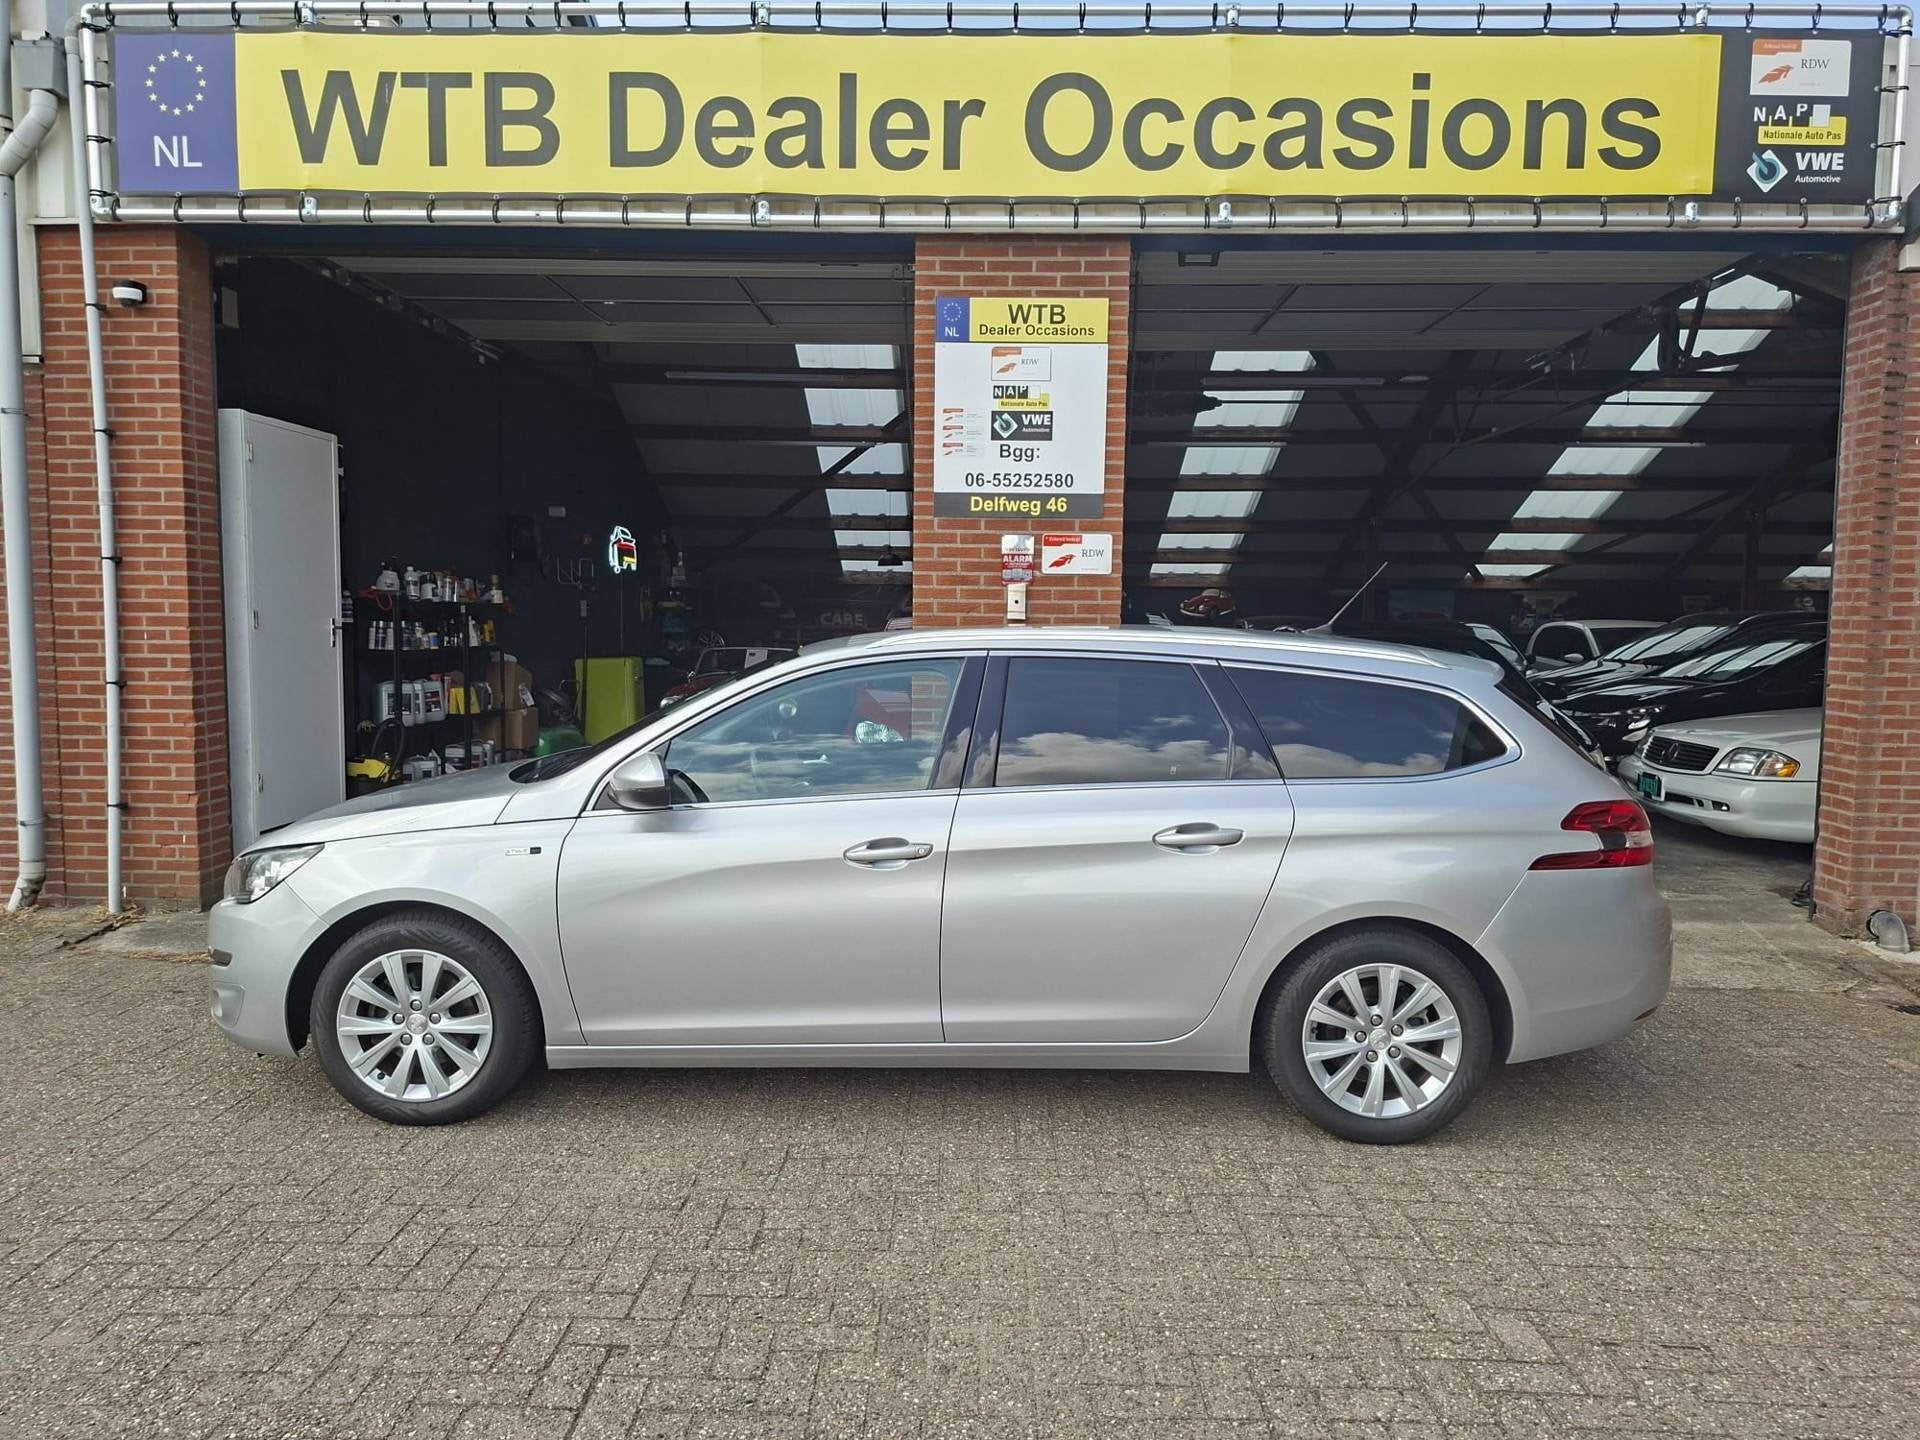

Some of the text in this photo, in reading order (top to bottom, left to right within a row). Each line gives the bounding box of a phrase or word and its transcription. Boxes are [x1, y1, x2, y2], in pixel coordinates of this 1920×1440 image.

[1800, 58, 1831, 70] RDW
[280, 69, 1662, 173] WTB Dealer Occasions
[1762, 130, 1842, 140] Nationale Auto Pas
[153, 136, 203, 168] NL
[1795, 152, 1845, 171] VWE
[1795, 174, 1842, 183] Automotive
[1008, 303, 1067, 325] WTB
[944, 327, 960, 337] NL
[979, 324, 1095, 336] Dealer Occasions
[1021, 413, 1051, 425] VWE
[999, 443, 1041, 463] Bgg:
[964, 472, 1075, 488] 06-55252580
[970, 496, 1068, 516] Delfweg 46
[1002, 555, 1034, 563] ALARM
[1081, 549, 1105, 558] RDW
[820, 613, 863, 626] CARE
